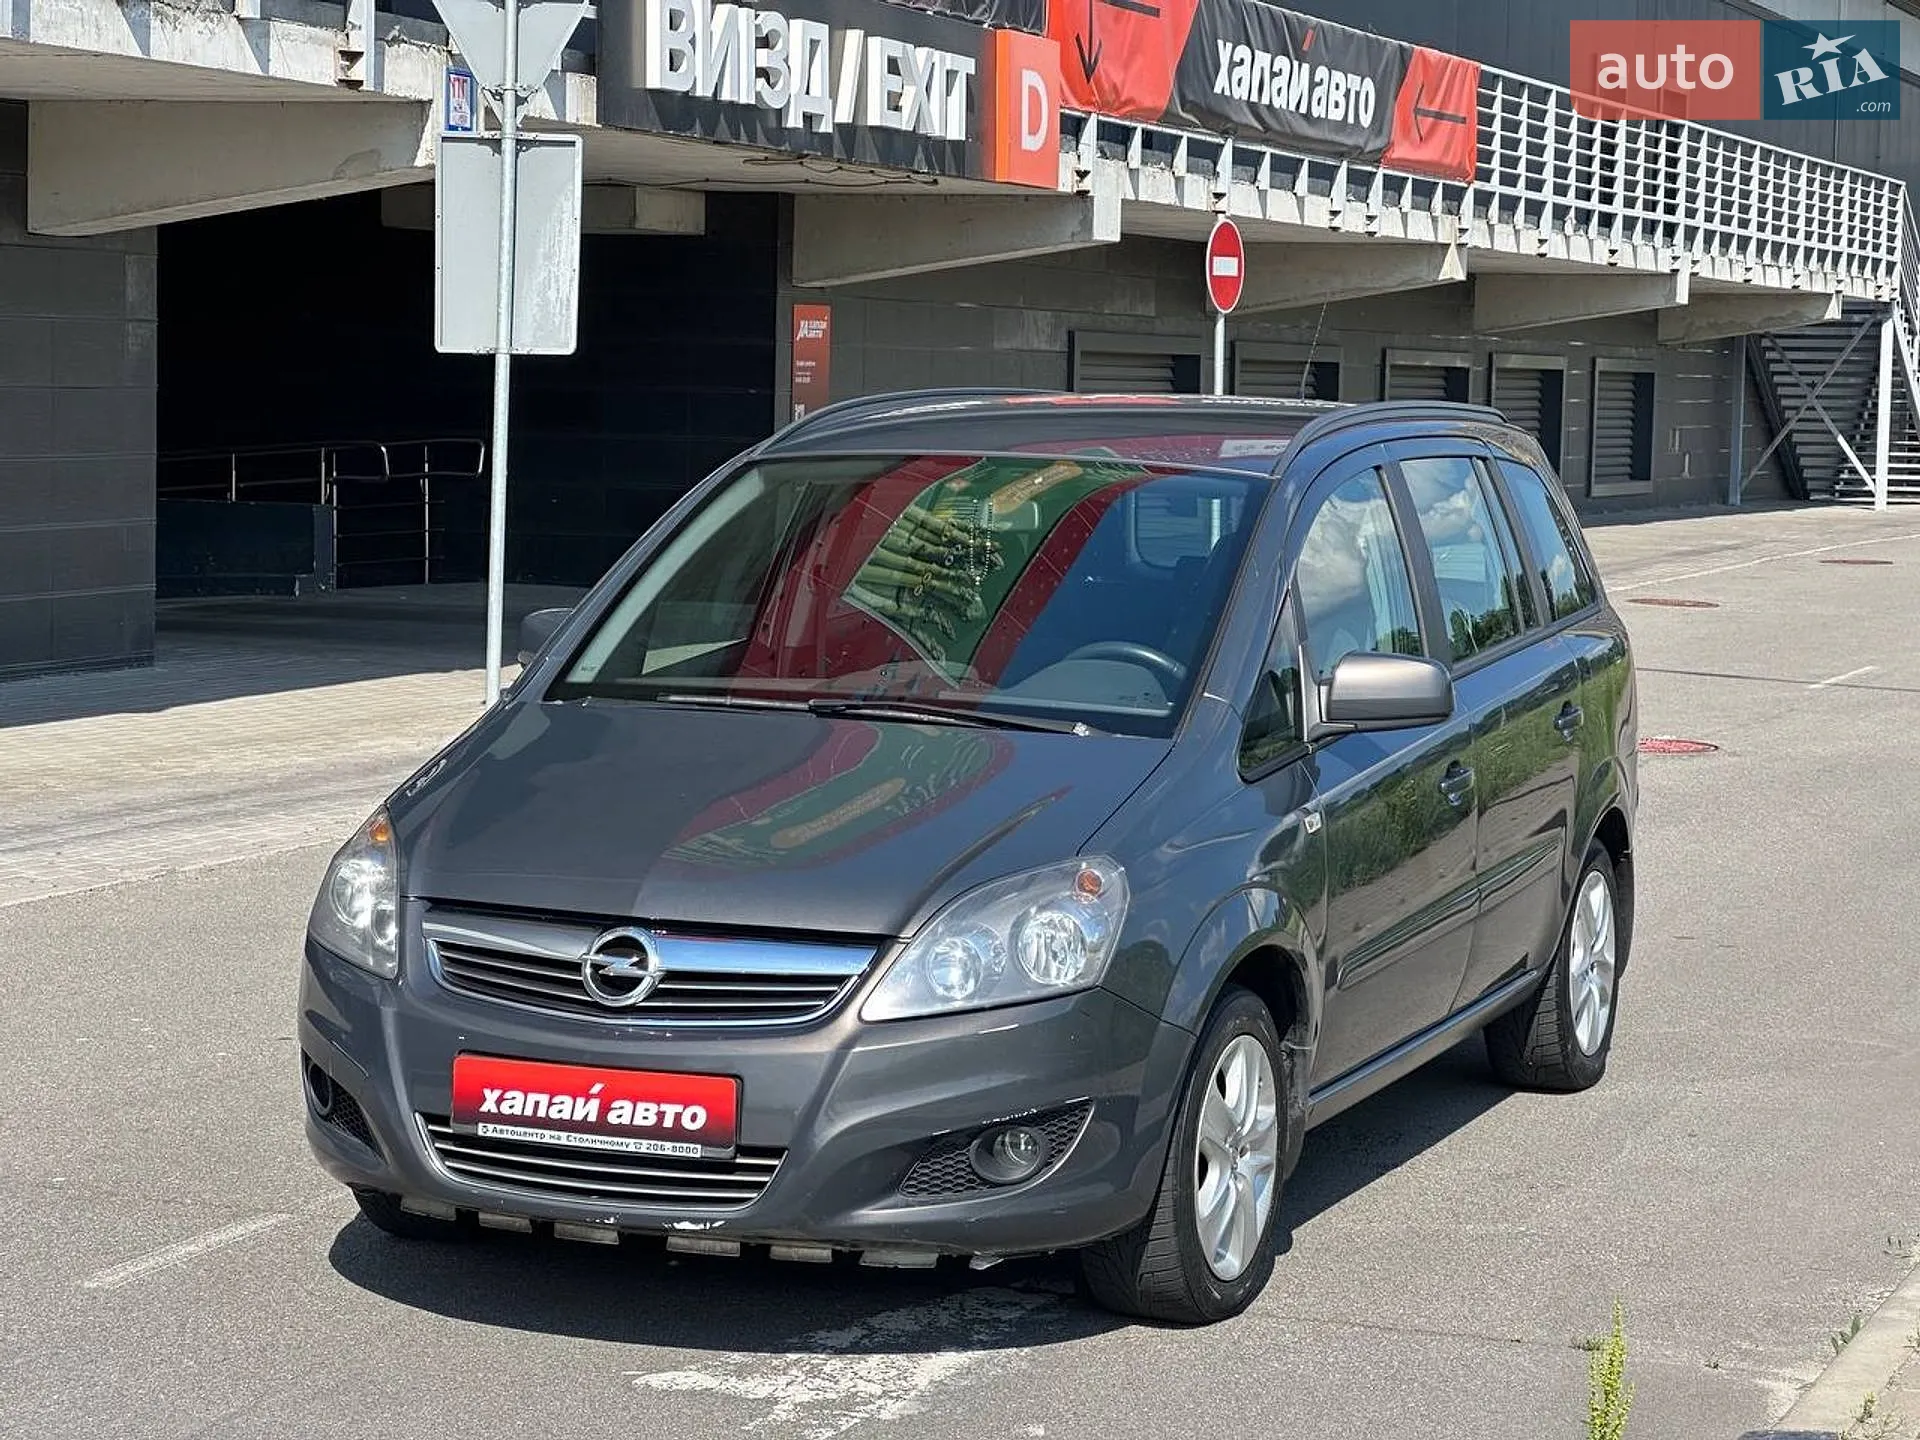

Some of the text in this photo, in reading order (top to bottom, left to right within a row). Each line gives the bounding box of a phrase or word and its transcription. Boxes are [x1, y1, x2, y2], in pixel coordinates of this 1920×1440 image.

[1020, 67, 1049, 152] D
[1310, 65, 1376, 128] авто
[479, 1082, 707, 1131] хапай авто
